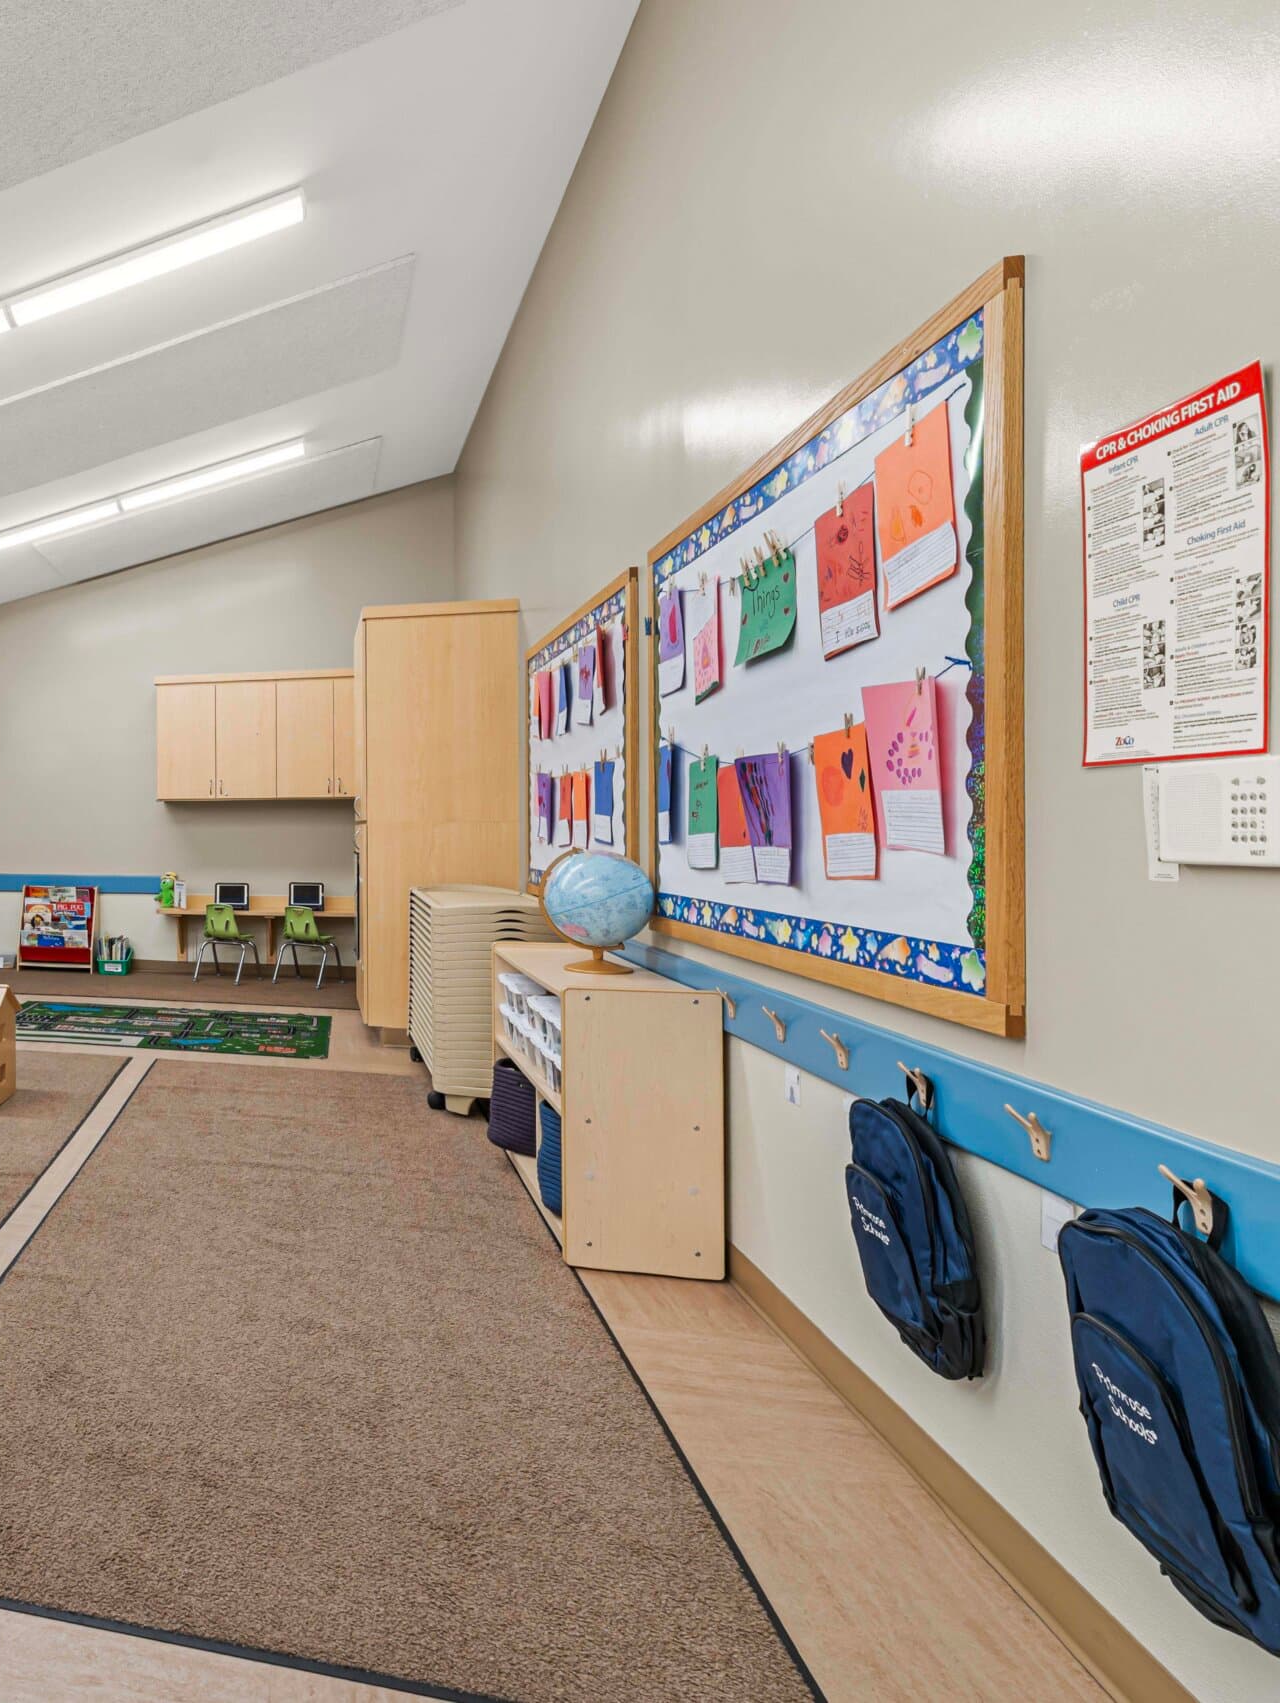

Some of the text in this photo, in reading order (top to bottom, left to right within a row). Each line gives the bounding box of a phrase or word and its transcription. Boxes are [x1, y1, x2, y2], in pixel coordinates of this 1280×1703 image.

[1095, 382, 1241, 460] CPR & CHOKING FIRST AID
[1194, 414, 1229, 436] Adult CPR
[1126, 455, 1139, 467] CPR
[1187, 520, 1246, 545] Choking First Aid
[1091, 1362, 1152, 1420] Primrose
[1108, 1394, 1158, 1445] Schools
